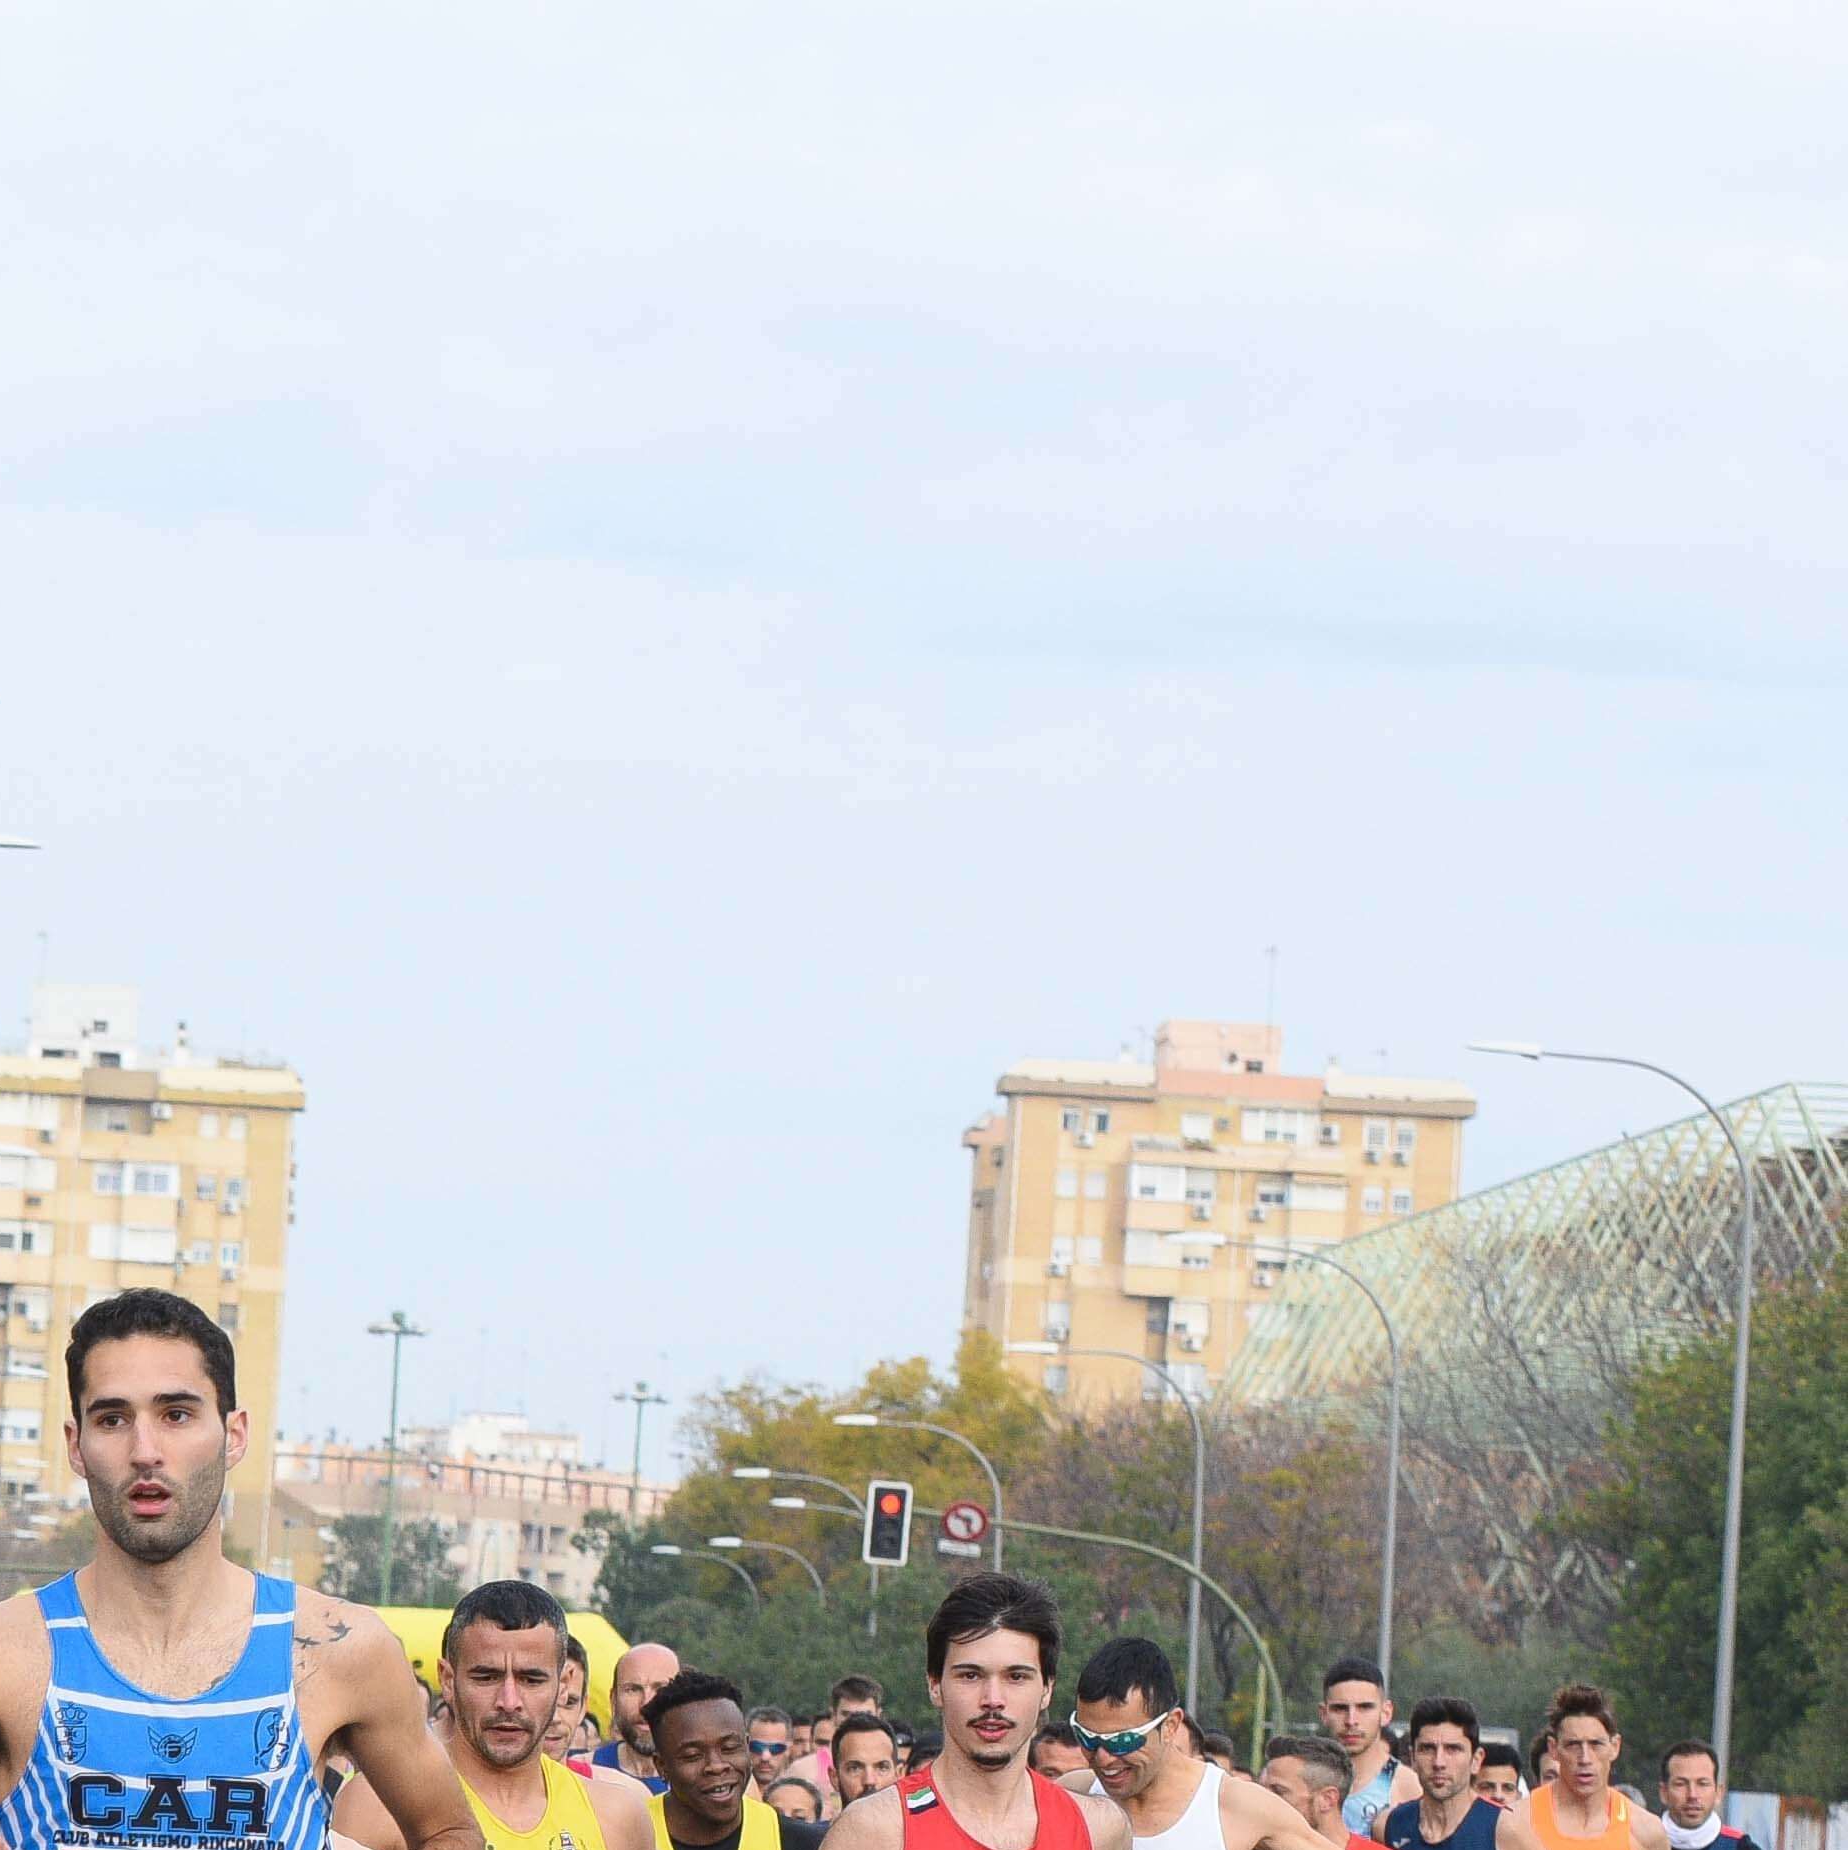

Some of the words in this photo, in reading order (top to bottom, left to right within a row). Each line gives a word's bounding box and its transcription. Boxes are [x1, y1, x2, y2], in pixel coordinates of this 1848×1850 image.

[67, 1772, 271, 1837] CAR
[54, 1829, 90, 1846] CLUB
[95, 1832, 193, 1849] ATLETISMO
